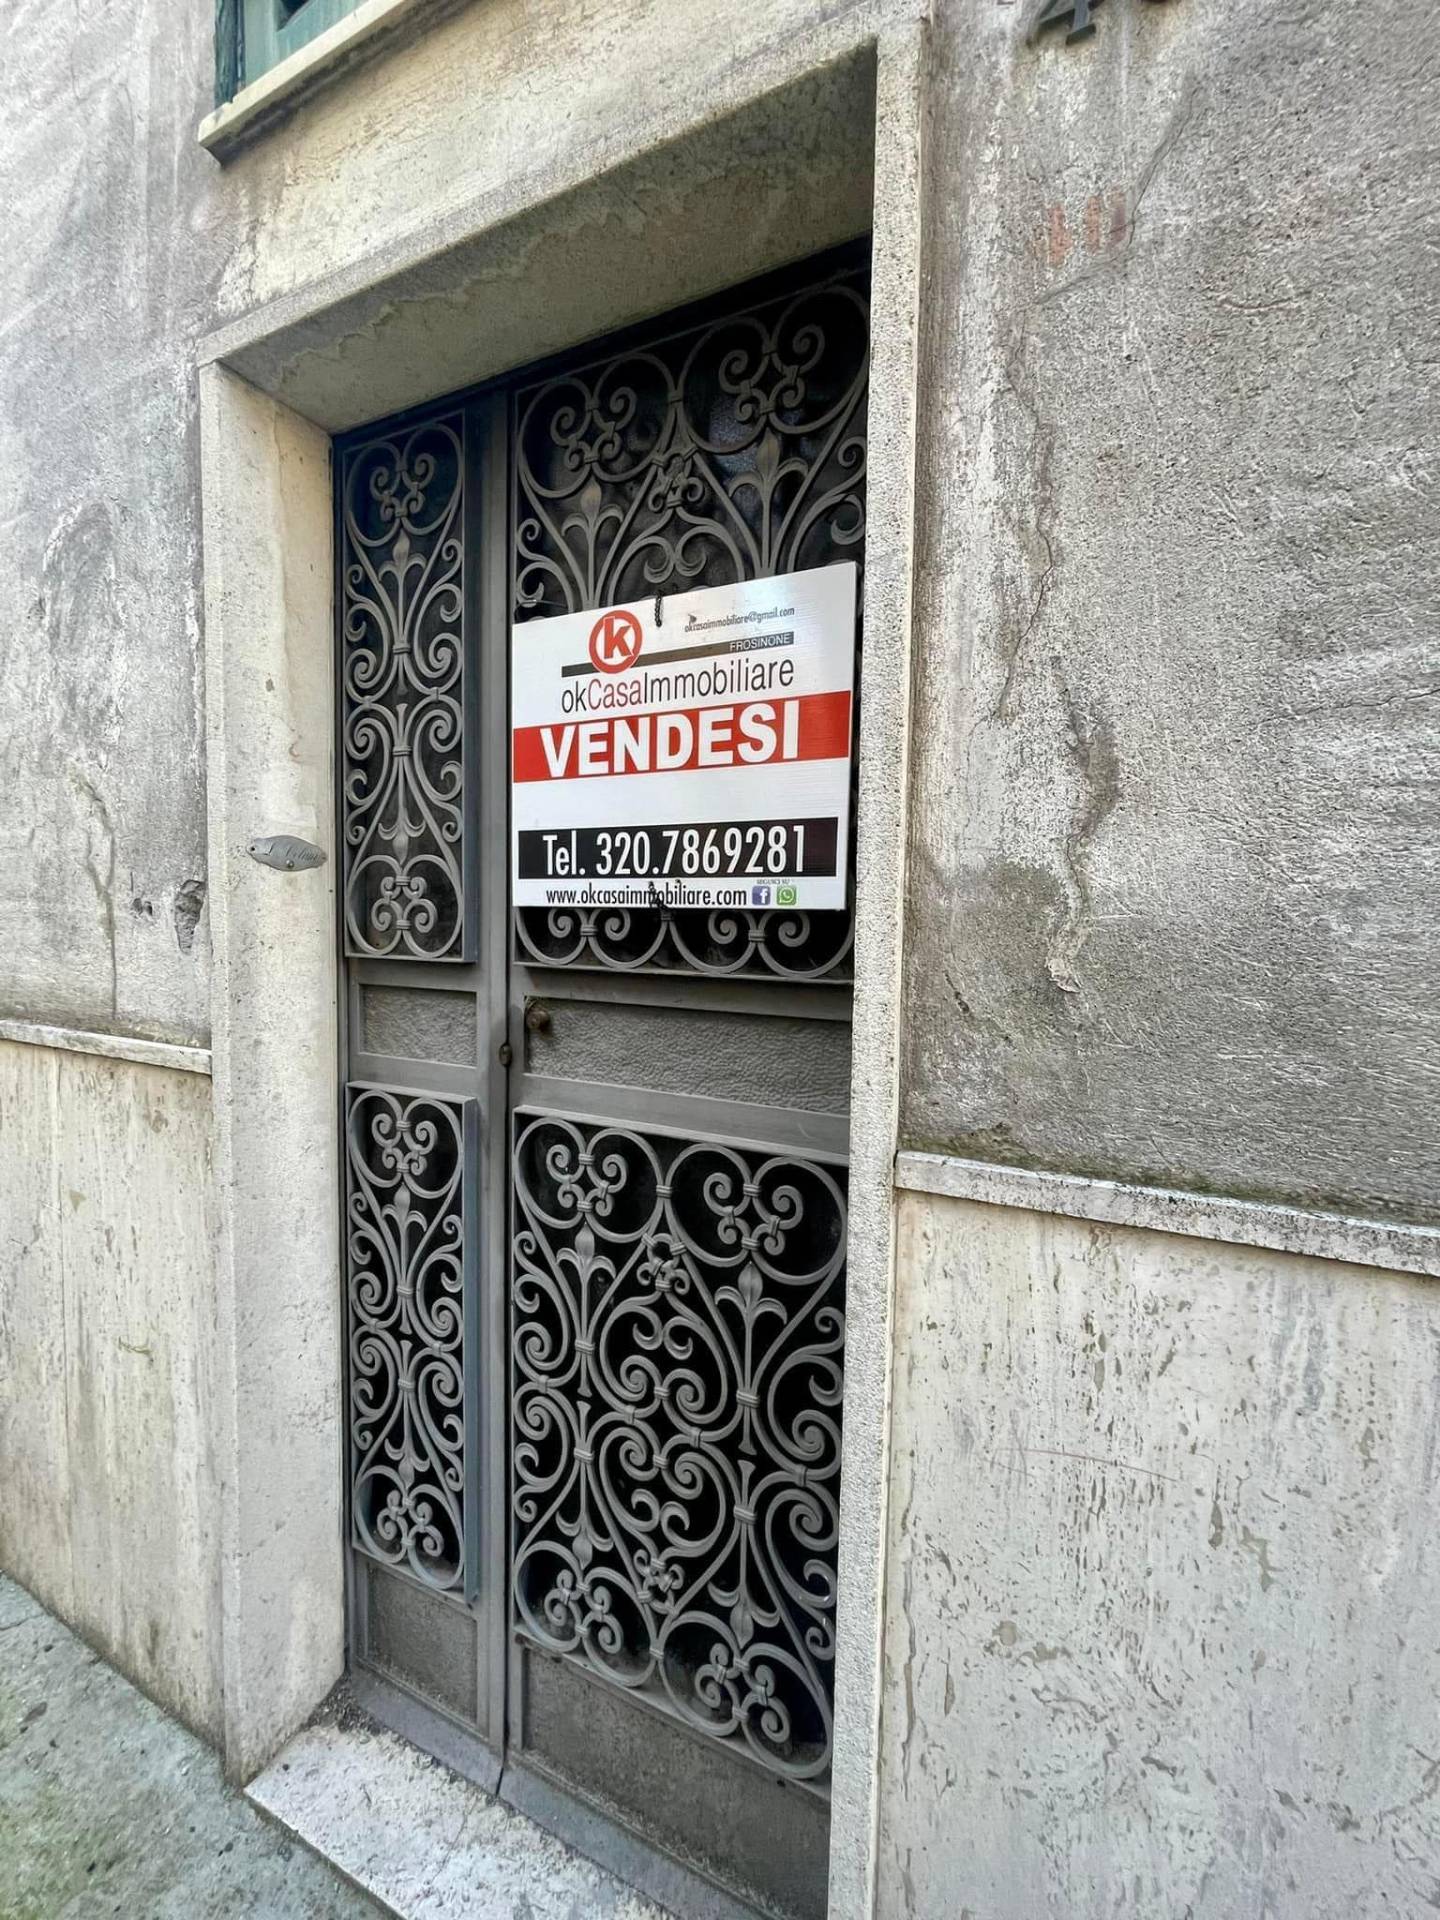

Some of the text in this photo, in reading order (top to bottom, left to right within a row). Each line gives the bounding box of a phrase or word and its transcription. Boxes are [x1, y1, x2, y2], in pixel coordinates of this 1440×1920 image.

[729, 633, 791, 652] FROSINONE
[561, 658, 795, 713] okCasaImmobiliare
[540, 700, 800, 778] VENDESI
[543, 825, 805, 875] Tel. 320.7869281
[546, 882, 747, 906] www.okcasaimmobiliare.com
